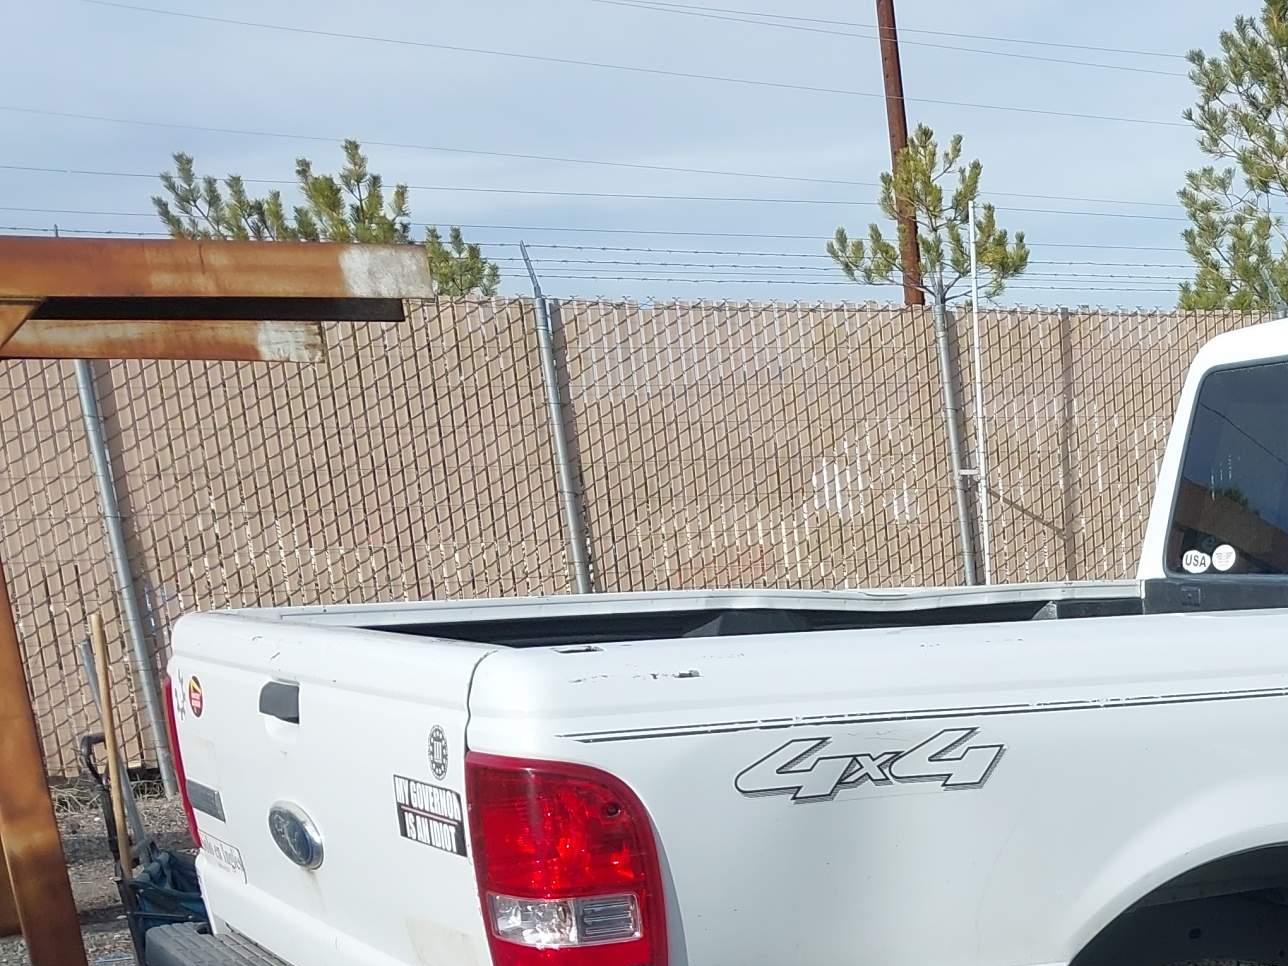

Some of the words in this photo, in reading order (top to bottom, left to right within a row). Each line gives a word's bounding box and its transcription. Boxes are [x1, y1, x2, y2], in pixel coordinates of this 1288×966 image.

[1185, 553, 1206, 568] USA
[394, 775, 410, 805] MY
[404, 811, 417, 841] IS
[415, 814, 431, 844] AN
[429, 818, 458, 853] IDIOT
